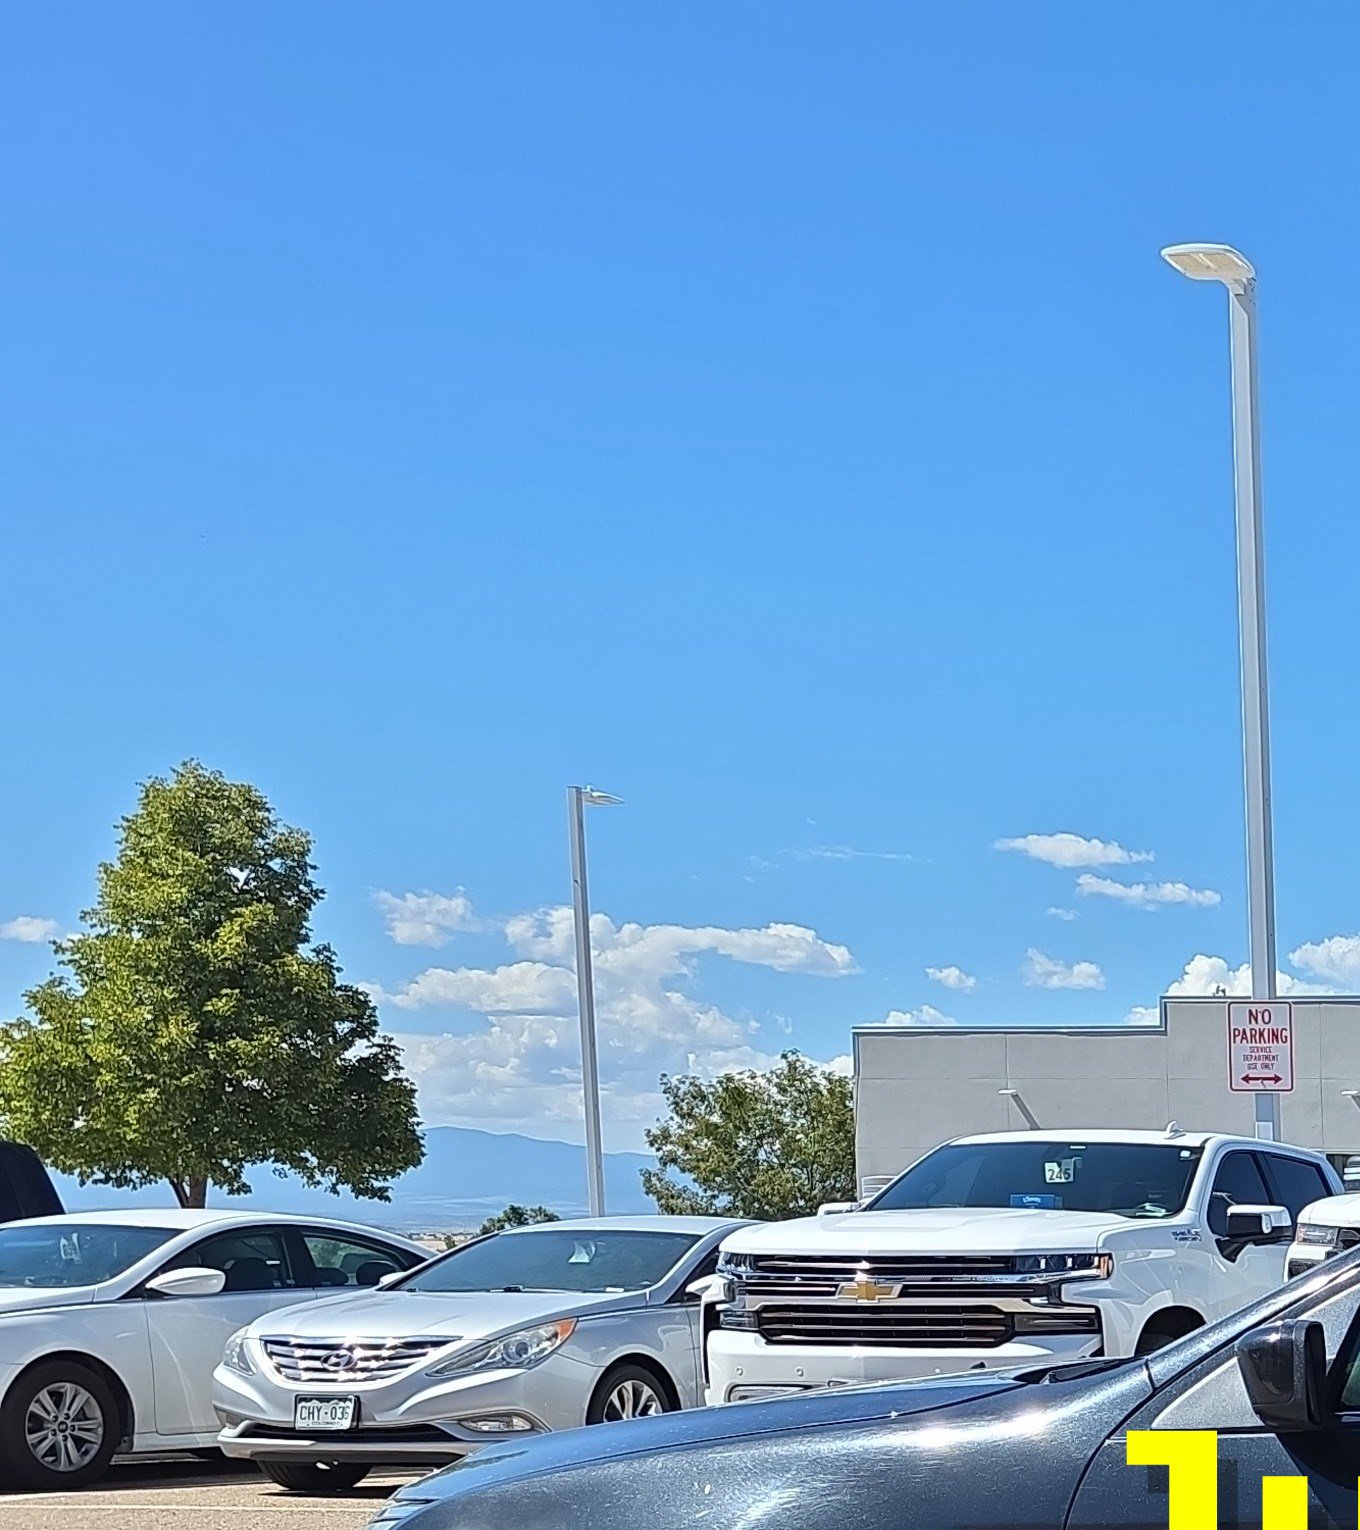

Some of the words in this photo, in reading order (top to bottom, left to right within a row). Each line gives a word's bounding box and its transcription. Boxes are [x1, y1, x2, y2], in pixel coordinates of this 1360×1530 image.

[1248, 1008, 1272, 1025] NO
[1232, 1027, 1288, 1044] PARKING
[1242, 1054, 1279, 1062] DEPARTMENT
